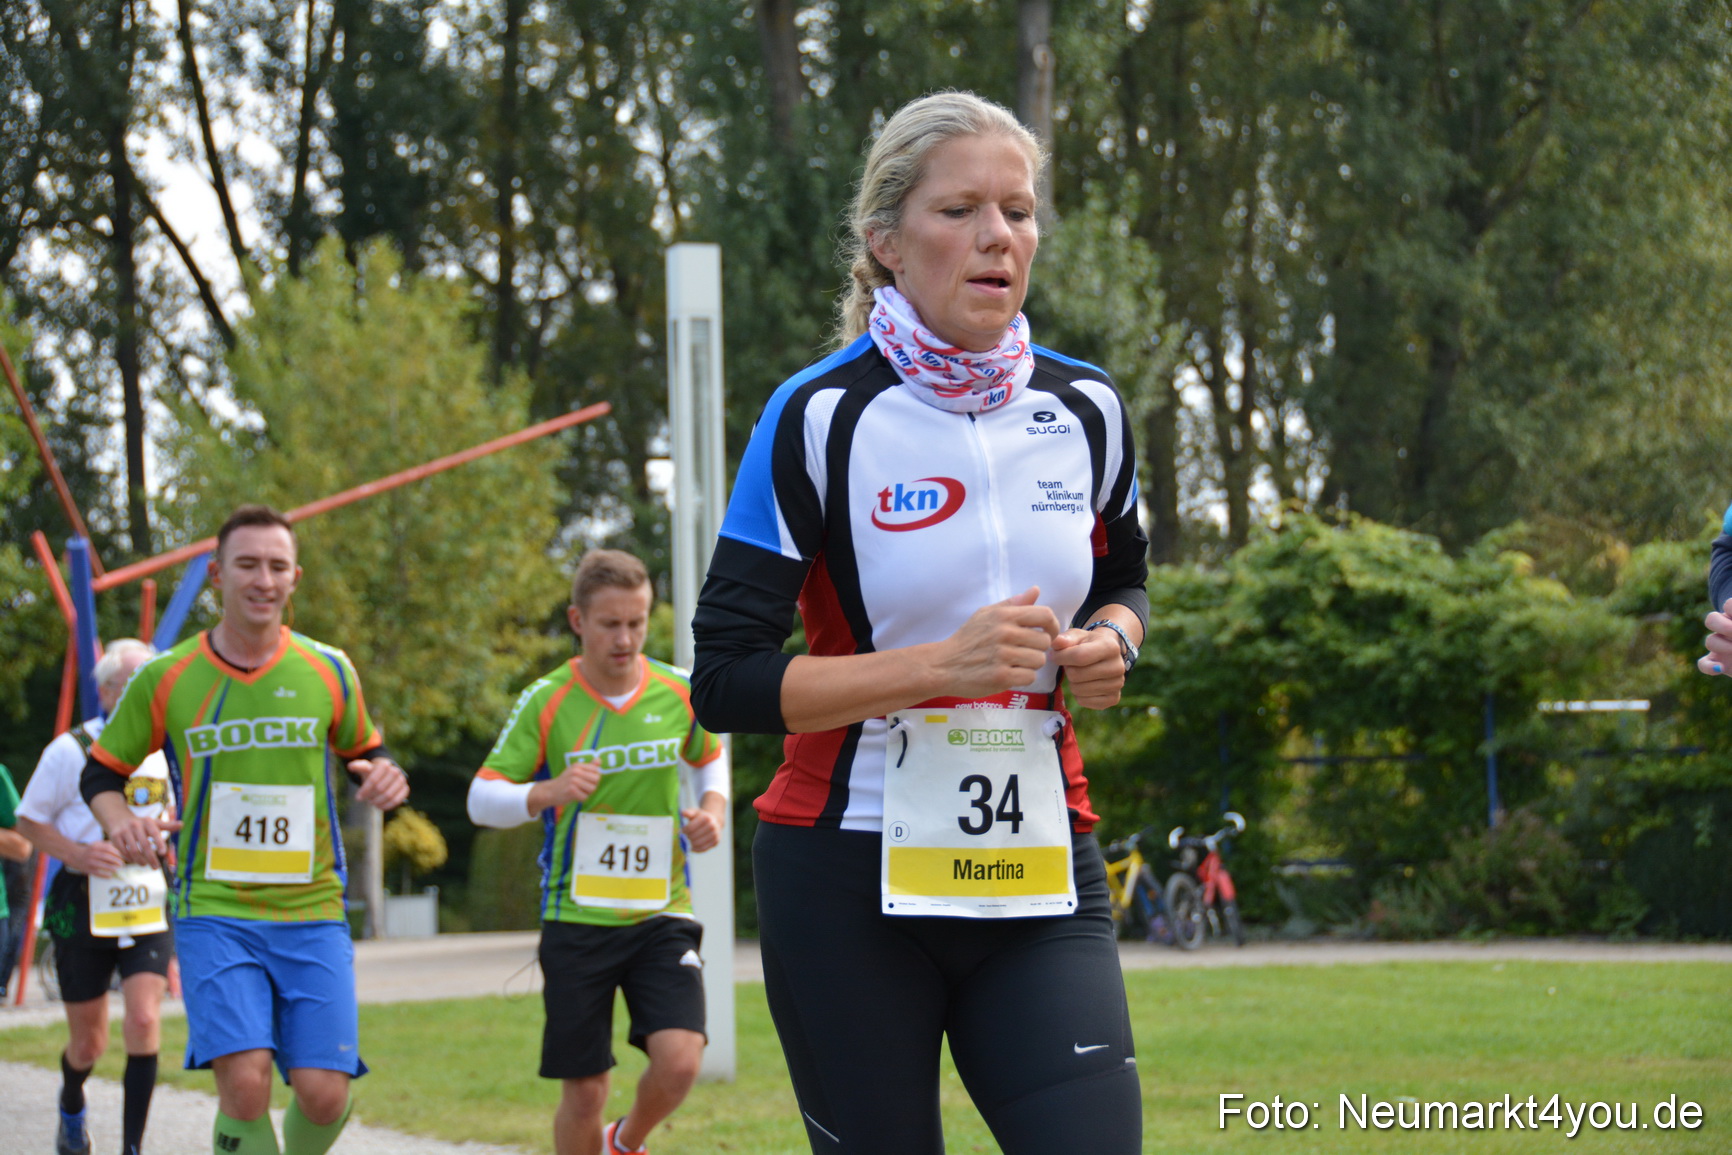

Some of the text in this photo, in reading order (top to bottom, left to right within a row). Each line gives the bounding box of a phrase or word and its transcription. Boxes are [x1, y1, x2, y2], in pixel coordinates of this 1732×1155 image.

[891, 343, 913, 367] tkn
[983, 389, 1006, 406] tkn
[1037, 480, 1063, 489] team
[1046, 490, 1084, 501] klinikum
[877, 483, 939, 513] tkn
[1031, 502, 1076, 514] nürnberg
[184, 717, 319, 758] BOCK
[970, 729, 1025, 746] BOCK
[957, 773, 1024, 836] 34
[235, 815, 290, 845] 418
[895, 826, 903, 838] D
[599, 844, 650, 872] 419
[953, 859, 1024, 880] Martina
[108, 885, 150, 908] 220
